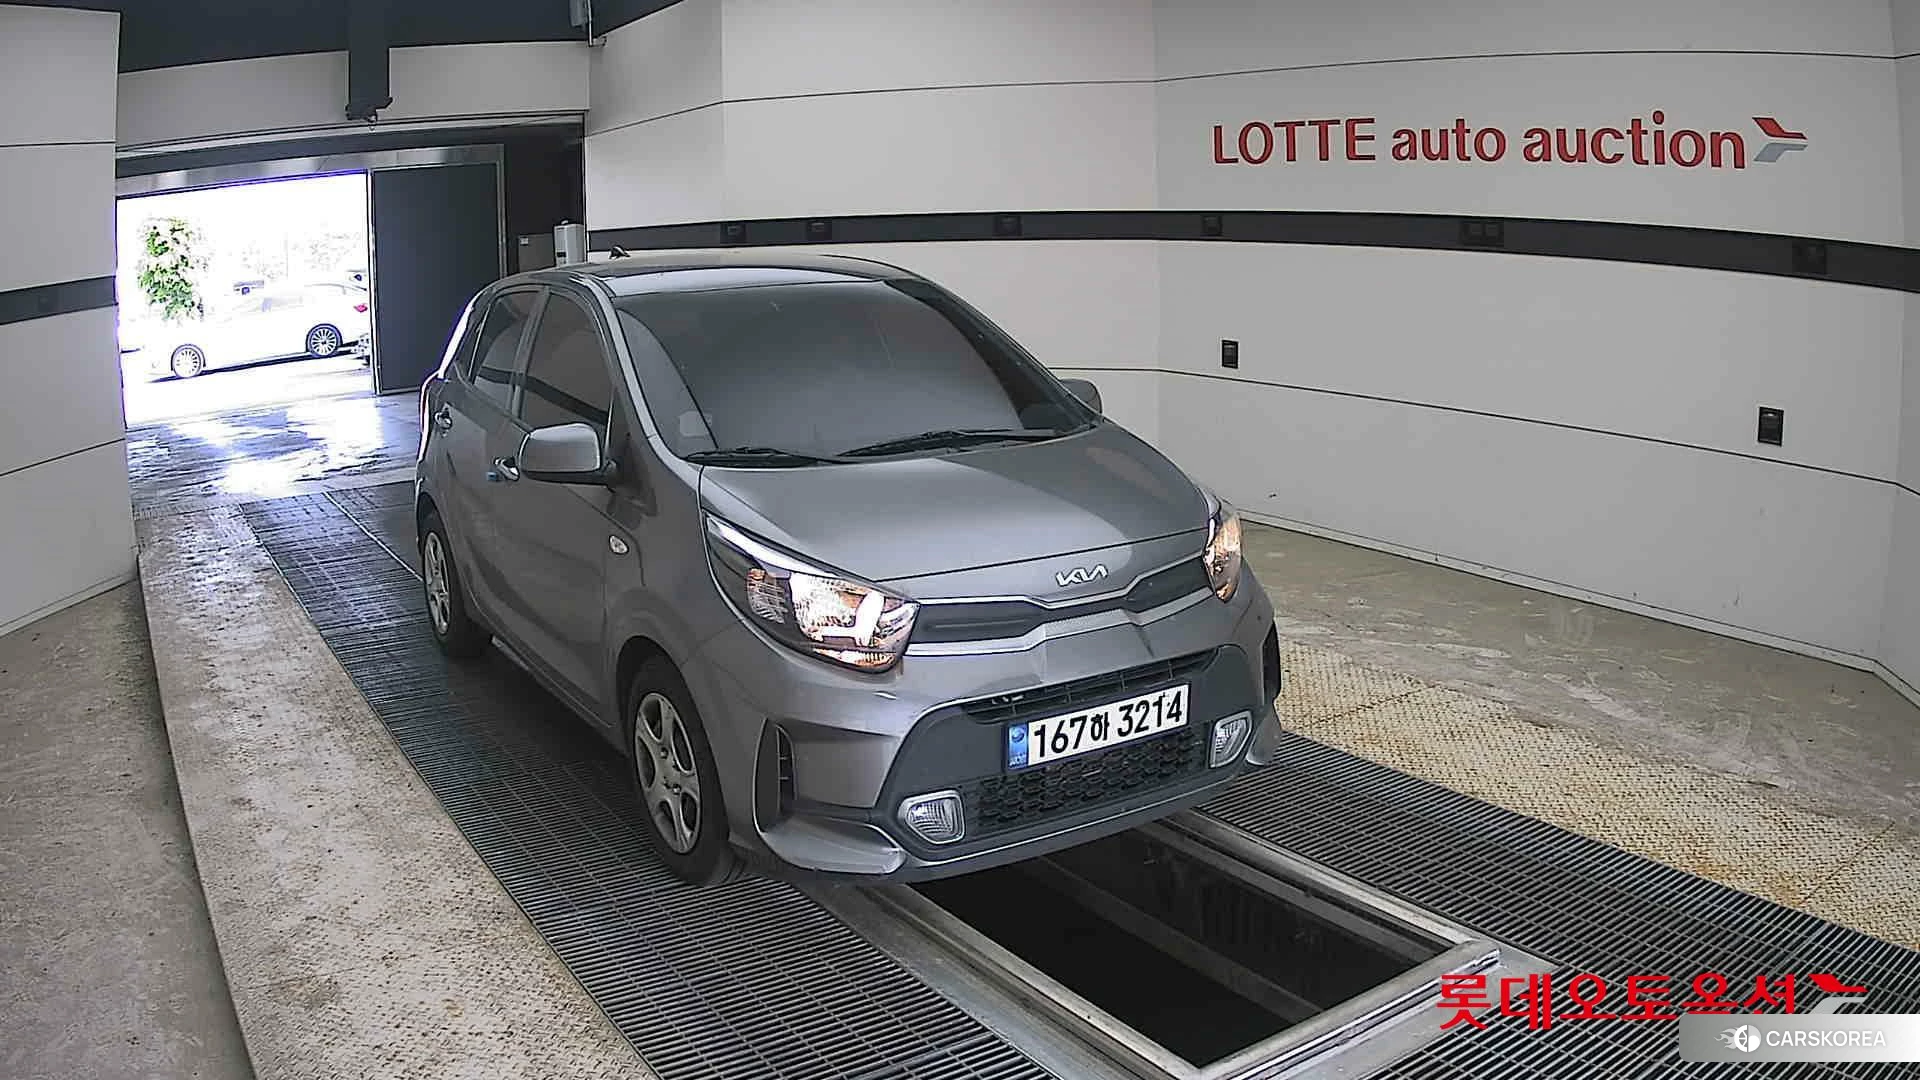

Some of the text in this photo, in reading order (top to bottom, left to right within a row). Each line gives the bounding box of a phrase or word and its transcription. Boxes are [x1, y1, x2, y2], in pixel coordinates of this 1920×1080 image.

[1212, 110, 1746, 169] LOTTE auto auction
[1033, 690, 1183, 758] 167하 3214
